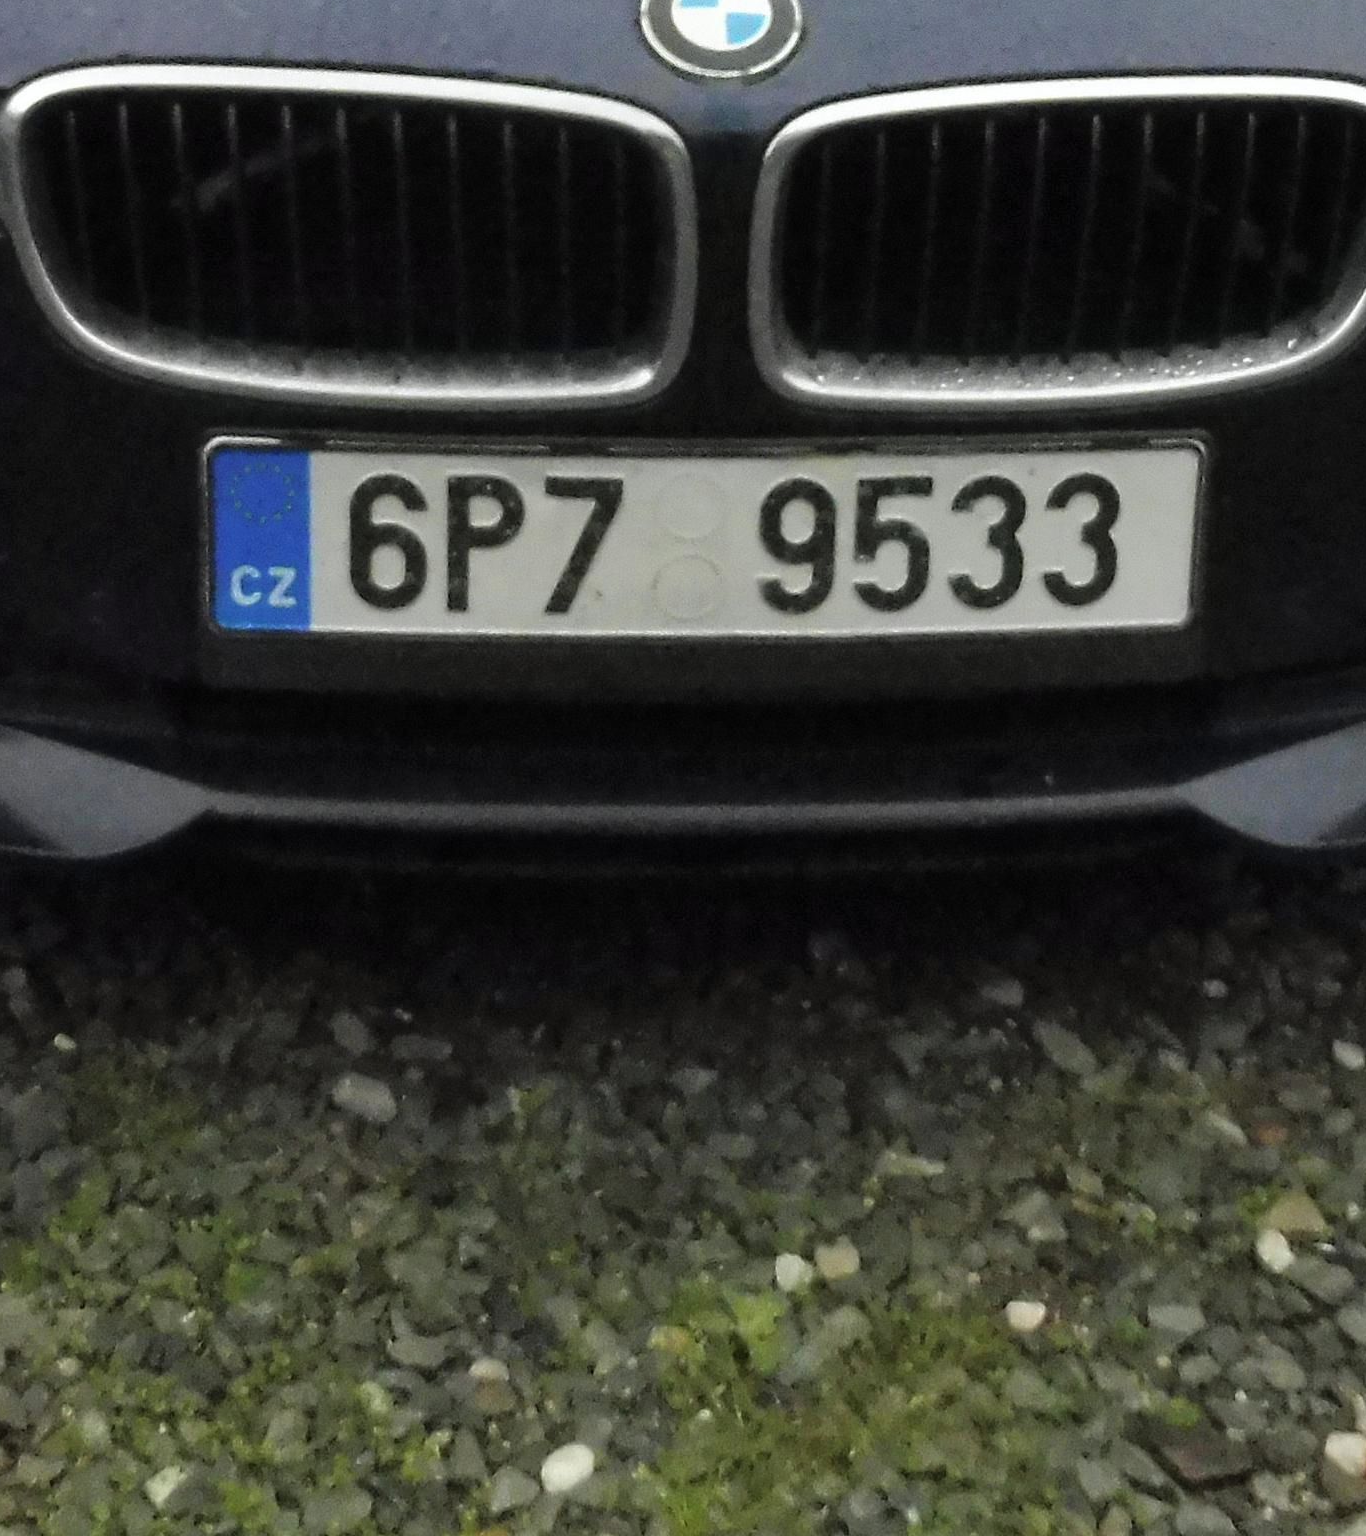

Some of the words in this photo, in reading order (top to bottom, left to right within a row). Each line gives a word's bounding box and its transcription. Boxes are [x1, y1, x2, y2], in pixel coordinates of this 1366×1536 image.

[230, 565, 297, 607] CZ
[348, 474, 625, 616] 6P7
[758, 472, 1121, 616] 9533
